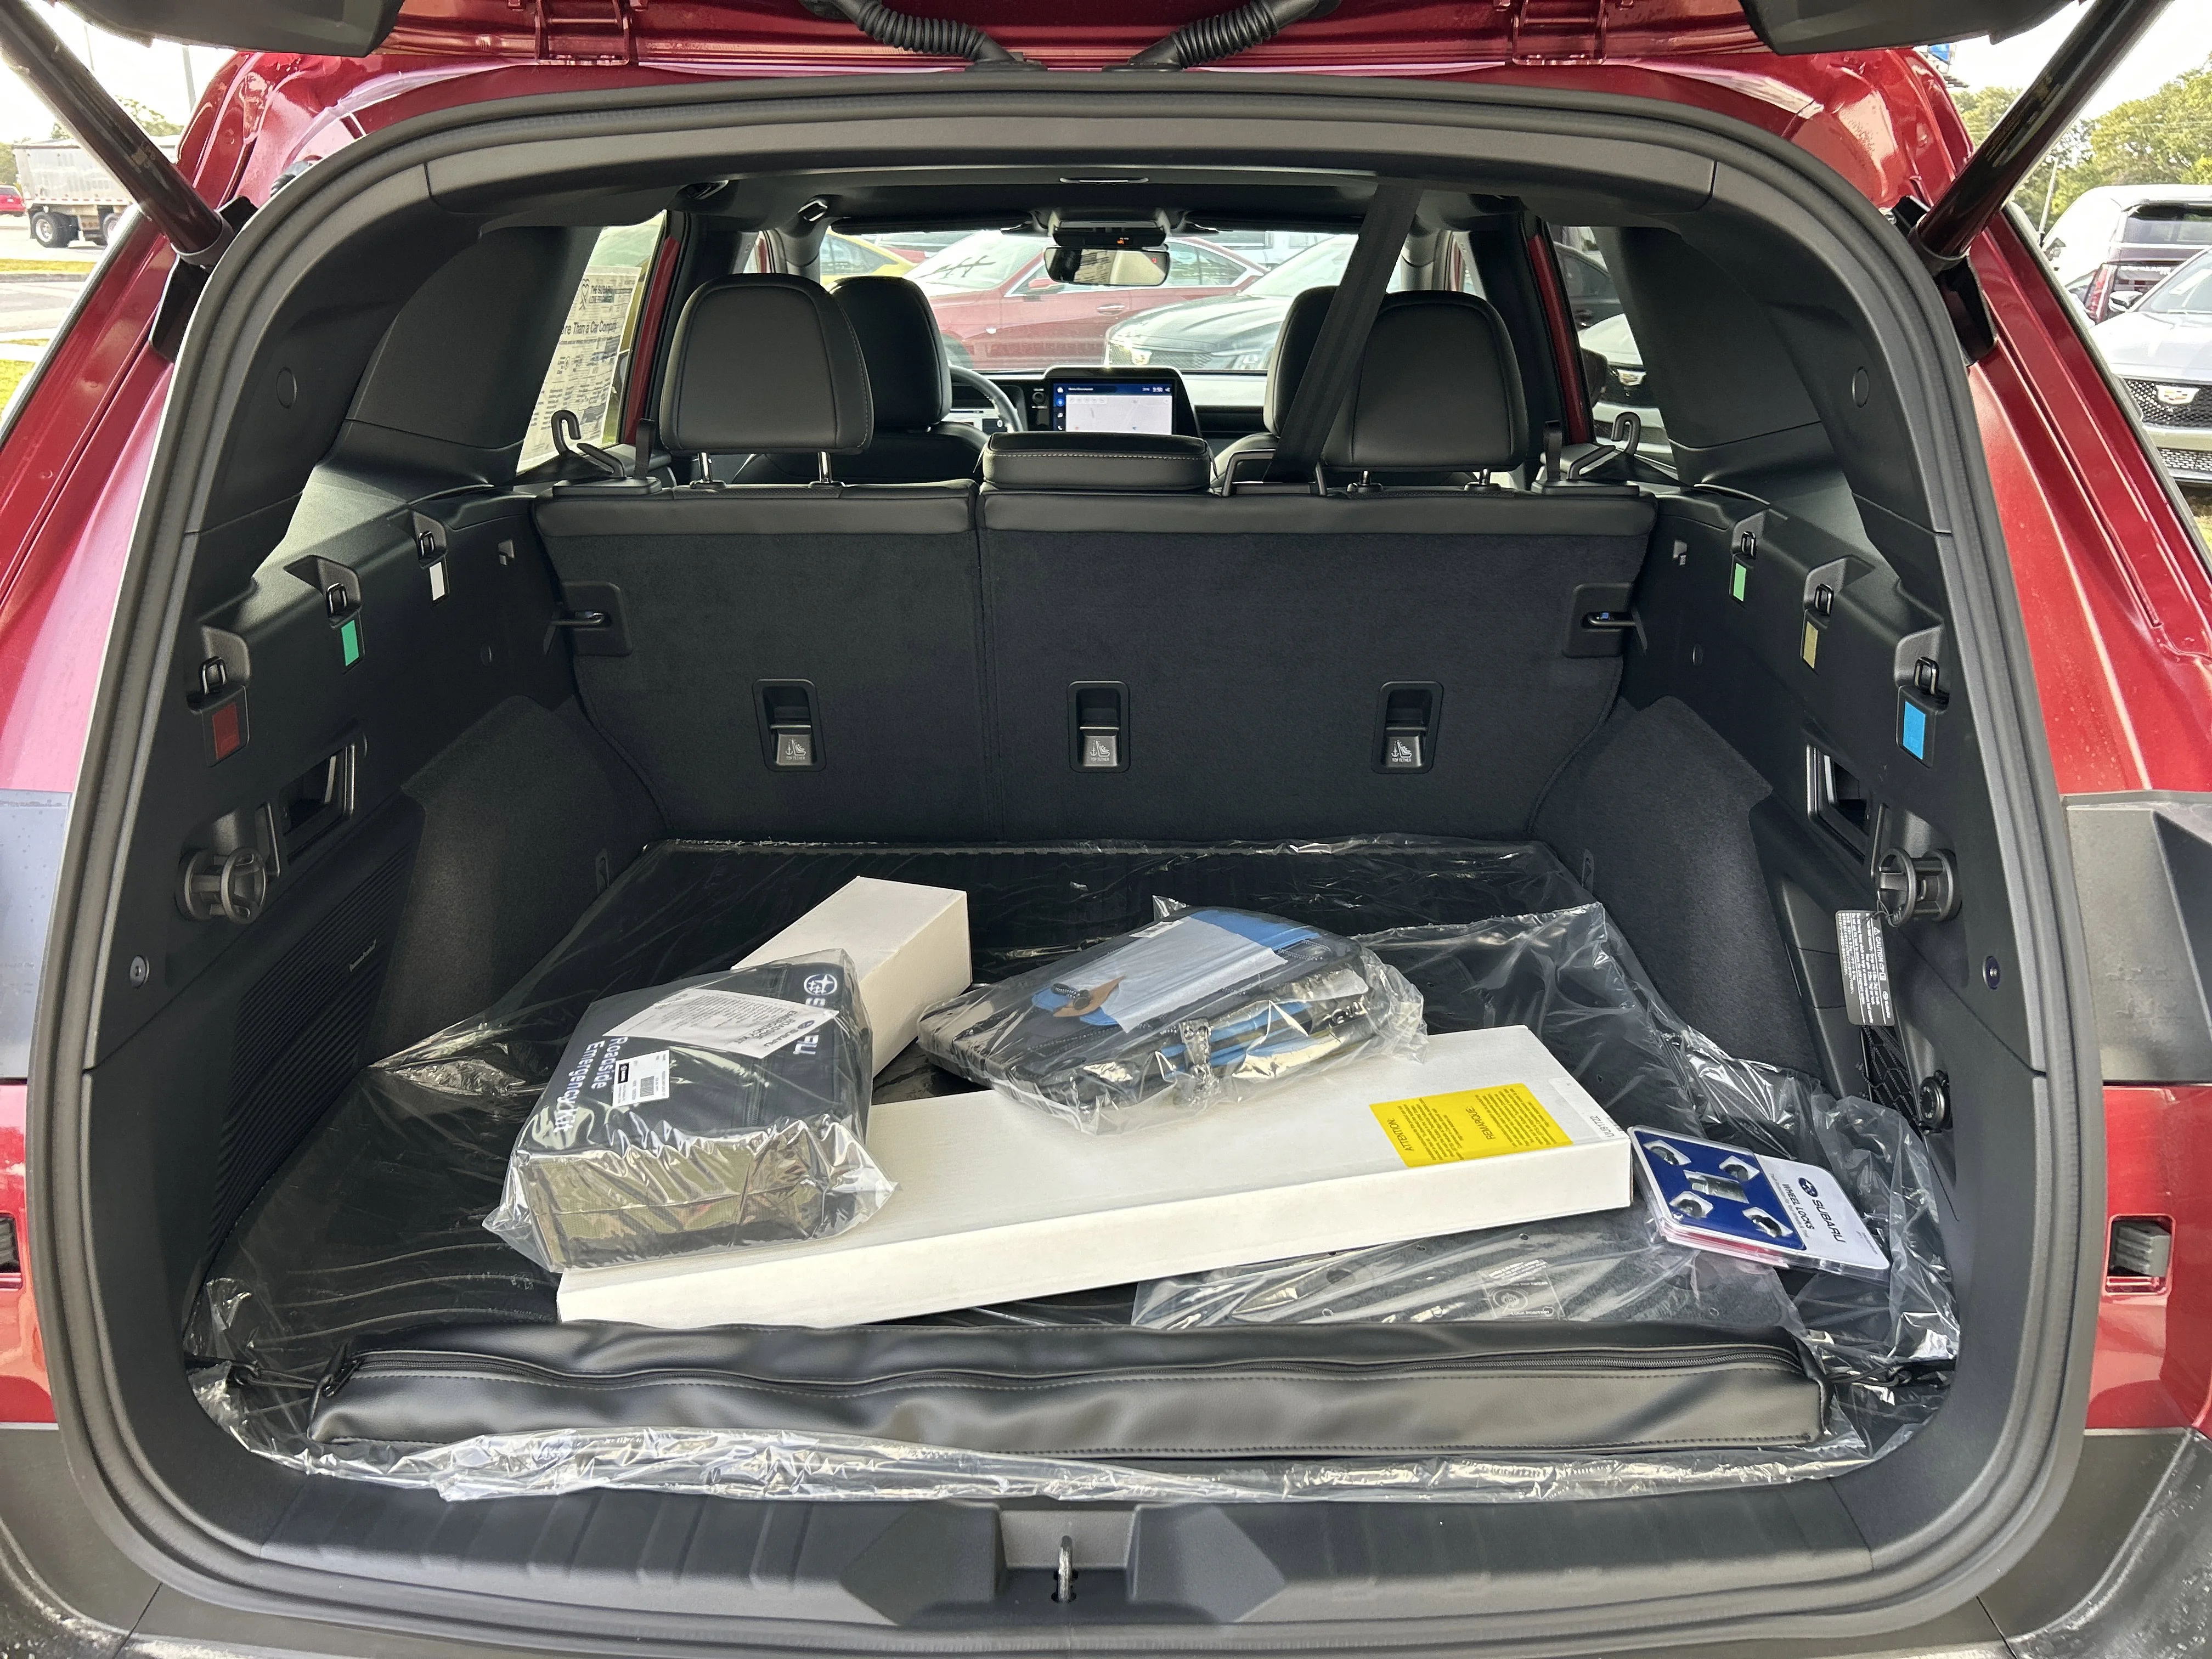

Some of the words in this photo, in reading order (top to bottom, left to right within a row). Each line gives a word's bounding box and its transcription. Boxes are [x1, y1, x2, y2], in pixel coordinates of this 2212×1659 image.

[573, 322, 585, 334] Than
[590, 321, 599, 333] Car
[1875, 936, 1883, 962] CAUTION
[749, 1010, 797, 1036] EMERGENCY
[755, 1019, 795, 1040] ROADSIDE
[763, 1029, 799, 1047] SUBARU
[557, 1040, 605, 1104] Emergency
[591, 1037, 628, 1090] Roadside
[1386, 1118, 1414, 1151] ATTENTION:
[1590, 1116, 1614, 1137] UU91722
[1782, 1183, 1801, 1205] WHEEL
[1796, 1207, 1815, 1230] LOCKS
[1812, 1199, 1847, 1243] SUBARU
